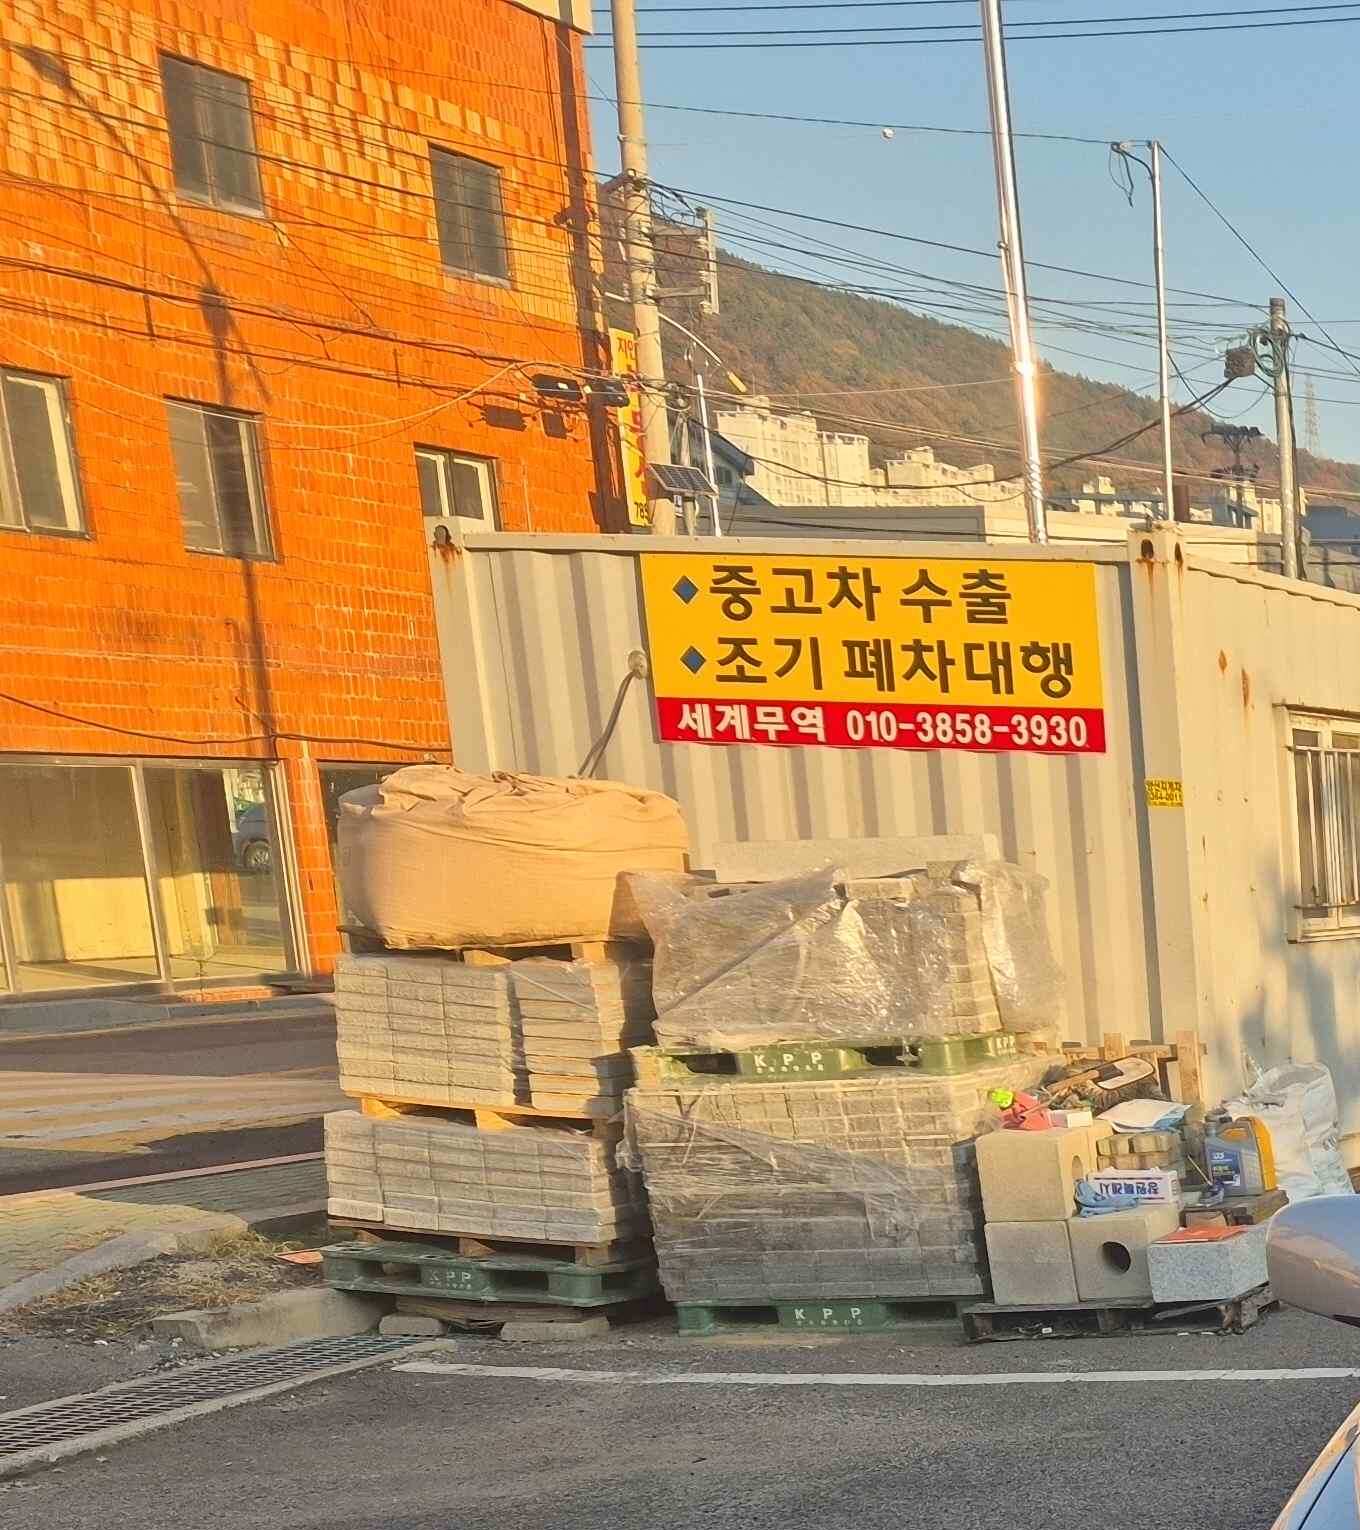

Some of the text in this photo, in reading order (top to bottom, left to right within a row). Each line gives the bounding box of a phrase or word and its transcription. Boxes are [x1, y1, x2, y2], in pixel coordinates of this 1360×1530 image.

[709, 564, 1013, 625] 중고차 수출
[715, 636, 1075, 699] 조기 폐차대행
[677, 703, 1088, 748] 세계무역 010-3858-3930
[753, 1051, 823, 1068] KPP
[793, 1307, 862, 1320] KPP
